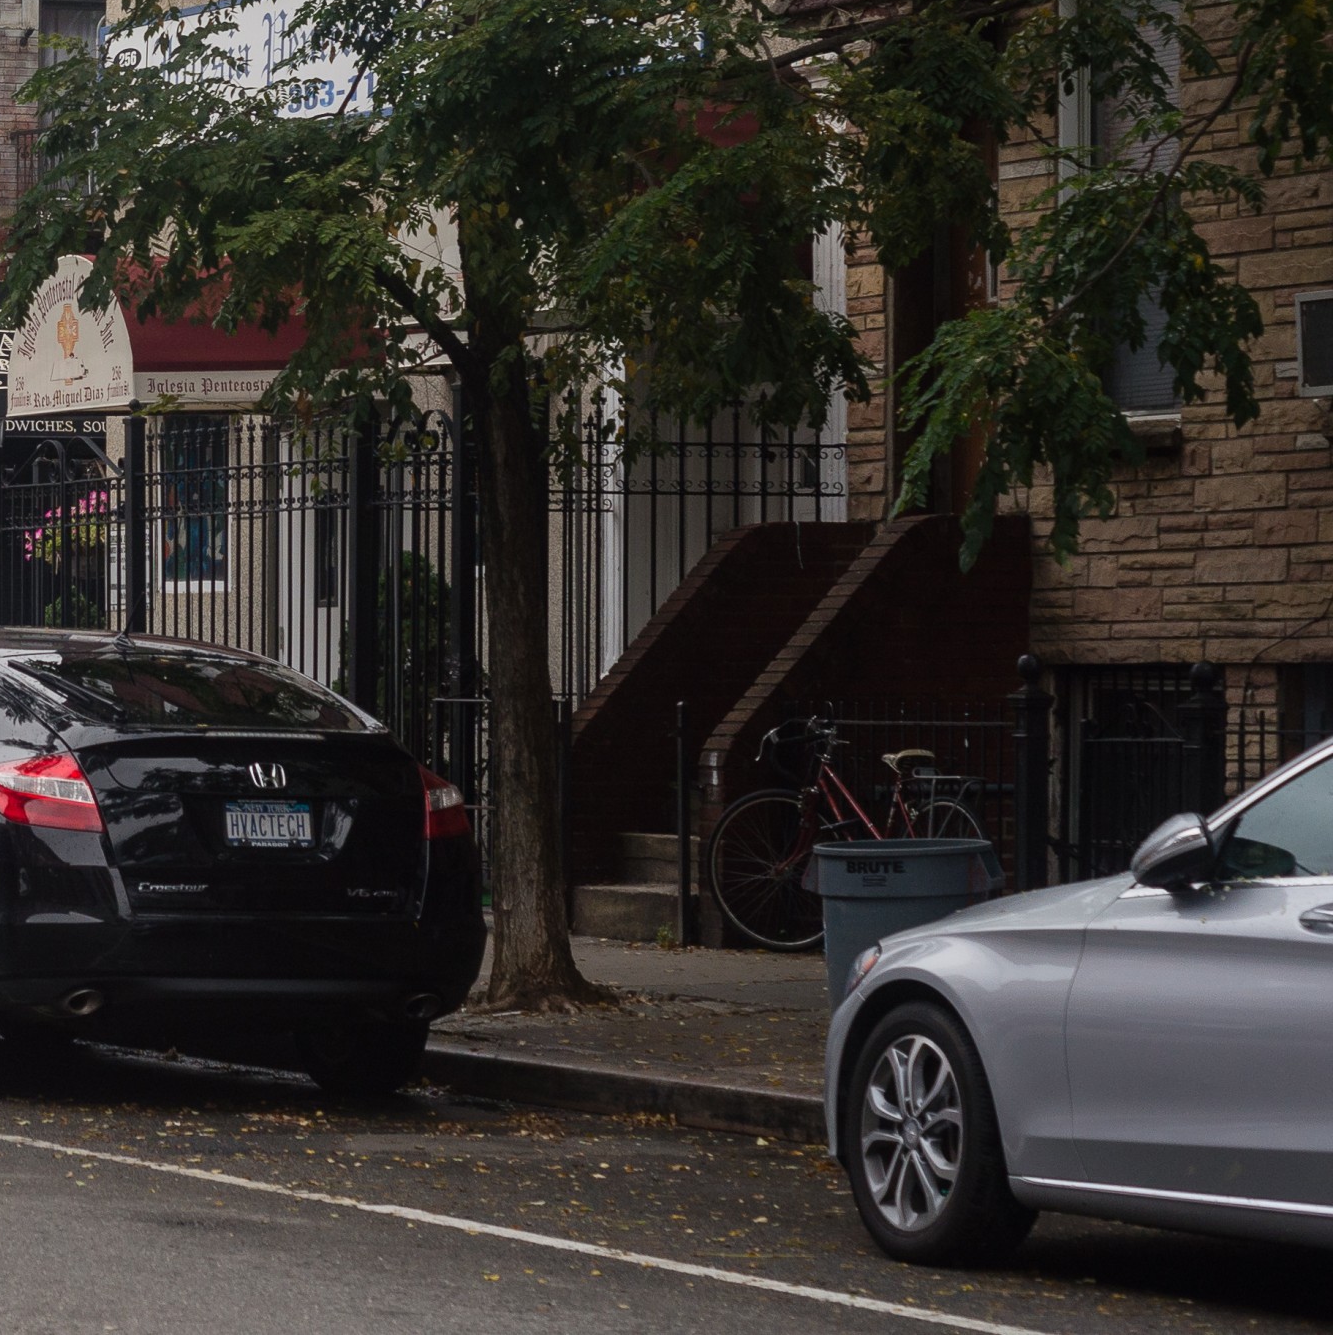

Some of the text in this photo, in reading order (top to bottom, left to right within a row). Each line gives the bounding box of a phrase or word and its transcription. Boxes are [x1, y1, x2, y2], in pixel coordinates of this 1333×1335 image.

[119, 50, 137, 66] 256
[147, 377, 275, 395] Iglesia Pentecosta
[53, 388, 82, 407] Miguel
[230, 814, 306, 838] HVACTECH
[846, 860, 906, 874] BRUTE
